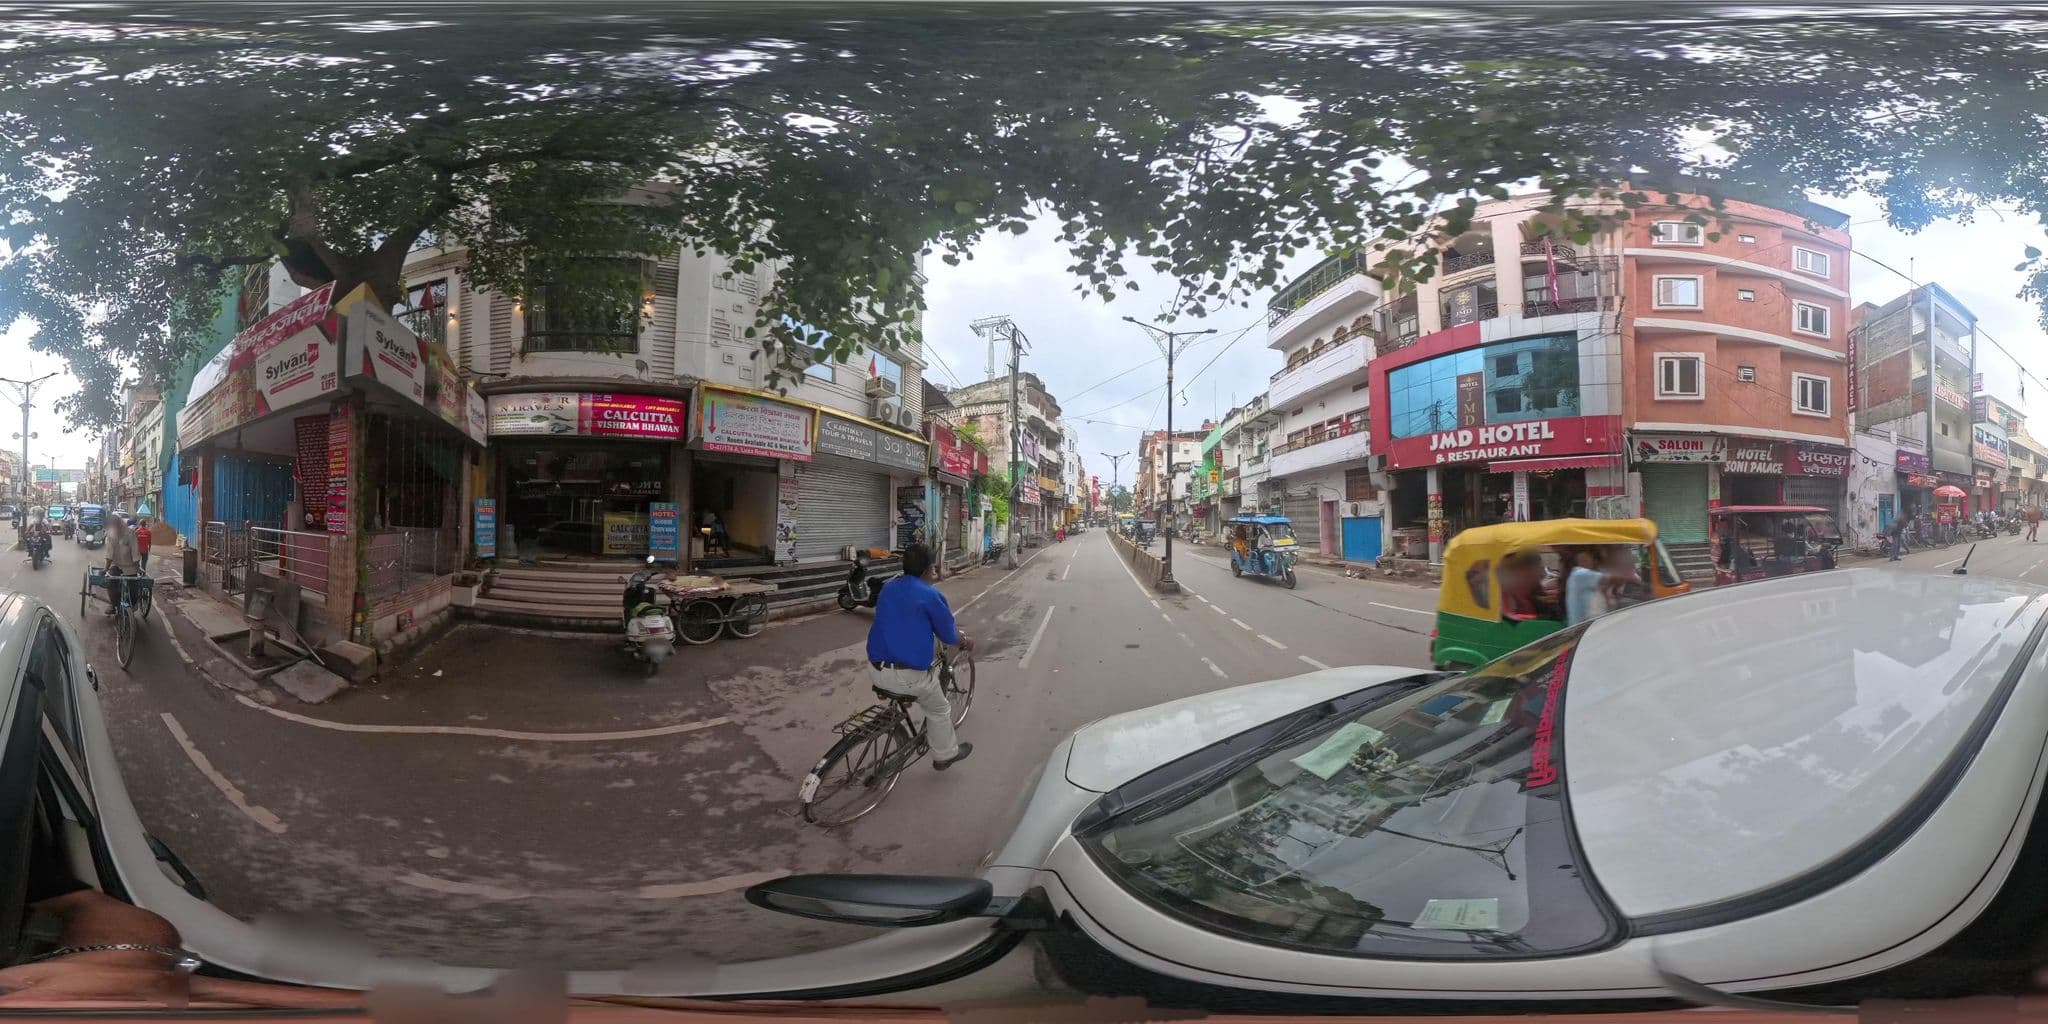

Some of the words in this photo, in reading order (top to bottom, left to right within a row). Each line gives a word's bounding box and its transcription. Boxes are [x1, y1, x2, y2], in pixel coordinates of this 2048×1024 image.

[375, 330, 411, 362] Sylvan
[266, 350, 307, 380] Sylvan
[321, 378, 336, 391] LIFE
[513, 404, 564, 412] TRAVES
[1464, 391, 1475, 426] JMD
[603, 409, 673, 424] CALCUTTA
[597, 420, 640, 431] VISHRAM
[641, 423, 680, 433] BHAWAN
[721, 429, 752, 438] CALCUTTA
[822, 429, 840, 439] TOUR
[847, 436, 873, 447] TRAVELS
[1430, 430, 1473, 451] JMD
[1479, 421, 1554, 445] HOTEL
[906, 441, 926, 461] Silks
[1658, 439, 1704, 450] SALONI
[1736, 444, 1773, 460] HOTEL
[1436, 454, 1446, 463] &
[1448, 444, 1541, 462] RESTAURANT
[1798, 451, 1849, 466] अप्सरा
[1724, 461, 1748, 473] SONI
[1750, 461, 1784, 474] PALACE
